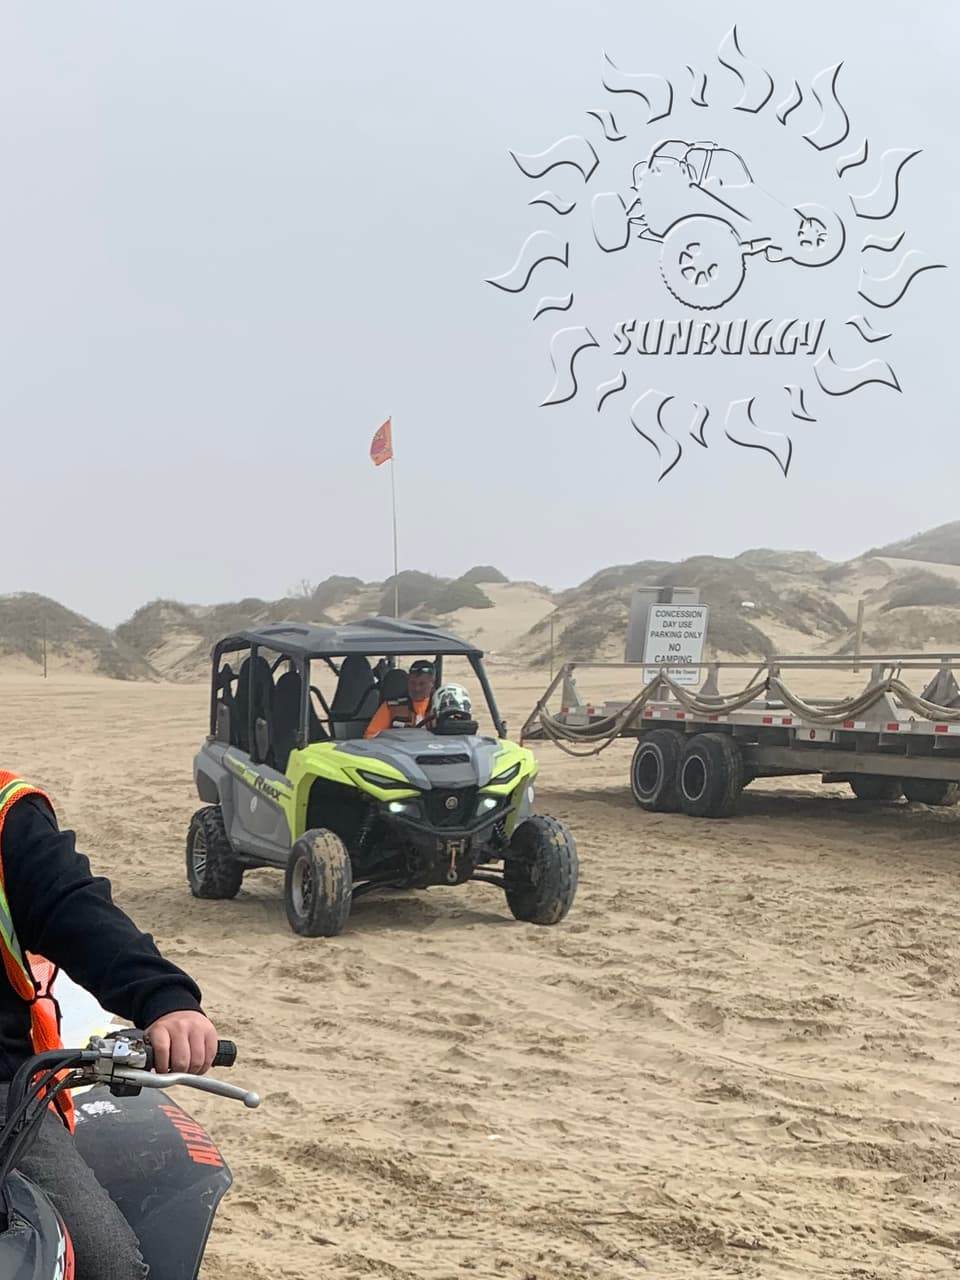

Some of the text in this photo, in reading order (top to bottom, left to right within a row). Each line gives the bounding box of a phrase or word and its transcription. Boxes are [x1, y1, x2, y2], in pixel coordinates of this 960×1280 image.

[655, 610, 703, 618] CONCESSION
[662, 620, 677, 628] DAY
[650, 630, 702, 639] PARKING ONLY
[668, 643, 681, 652] NO
[654, 655, 692, 664] CAMPING
